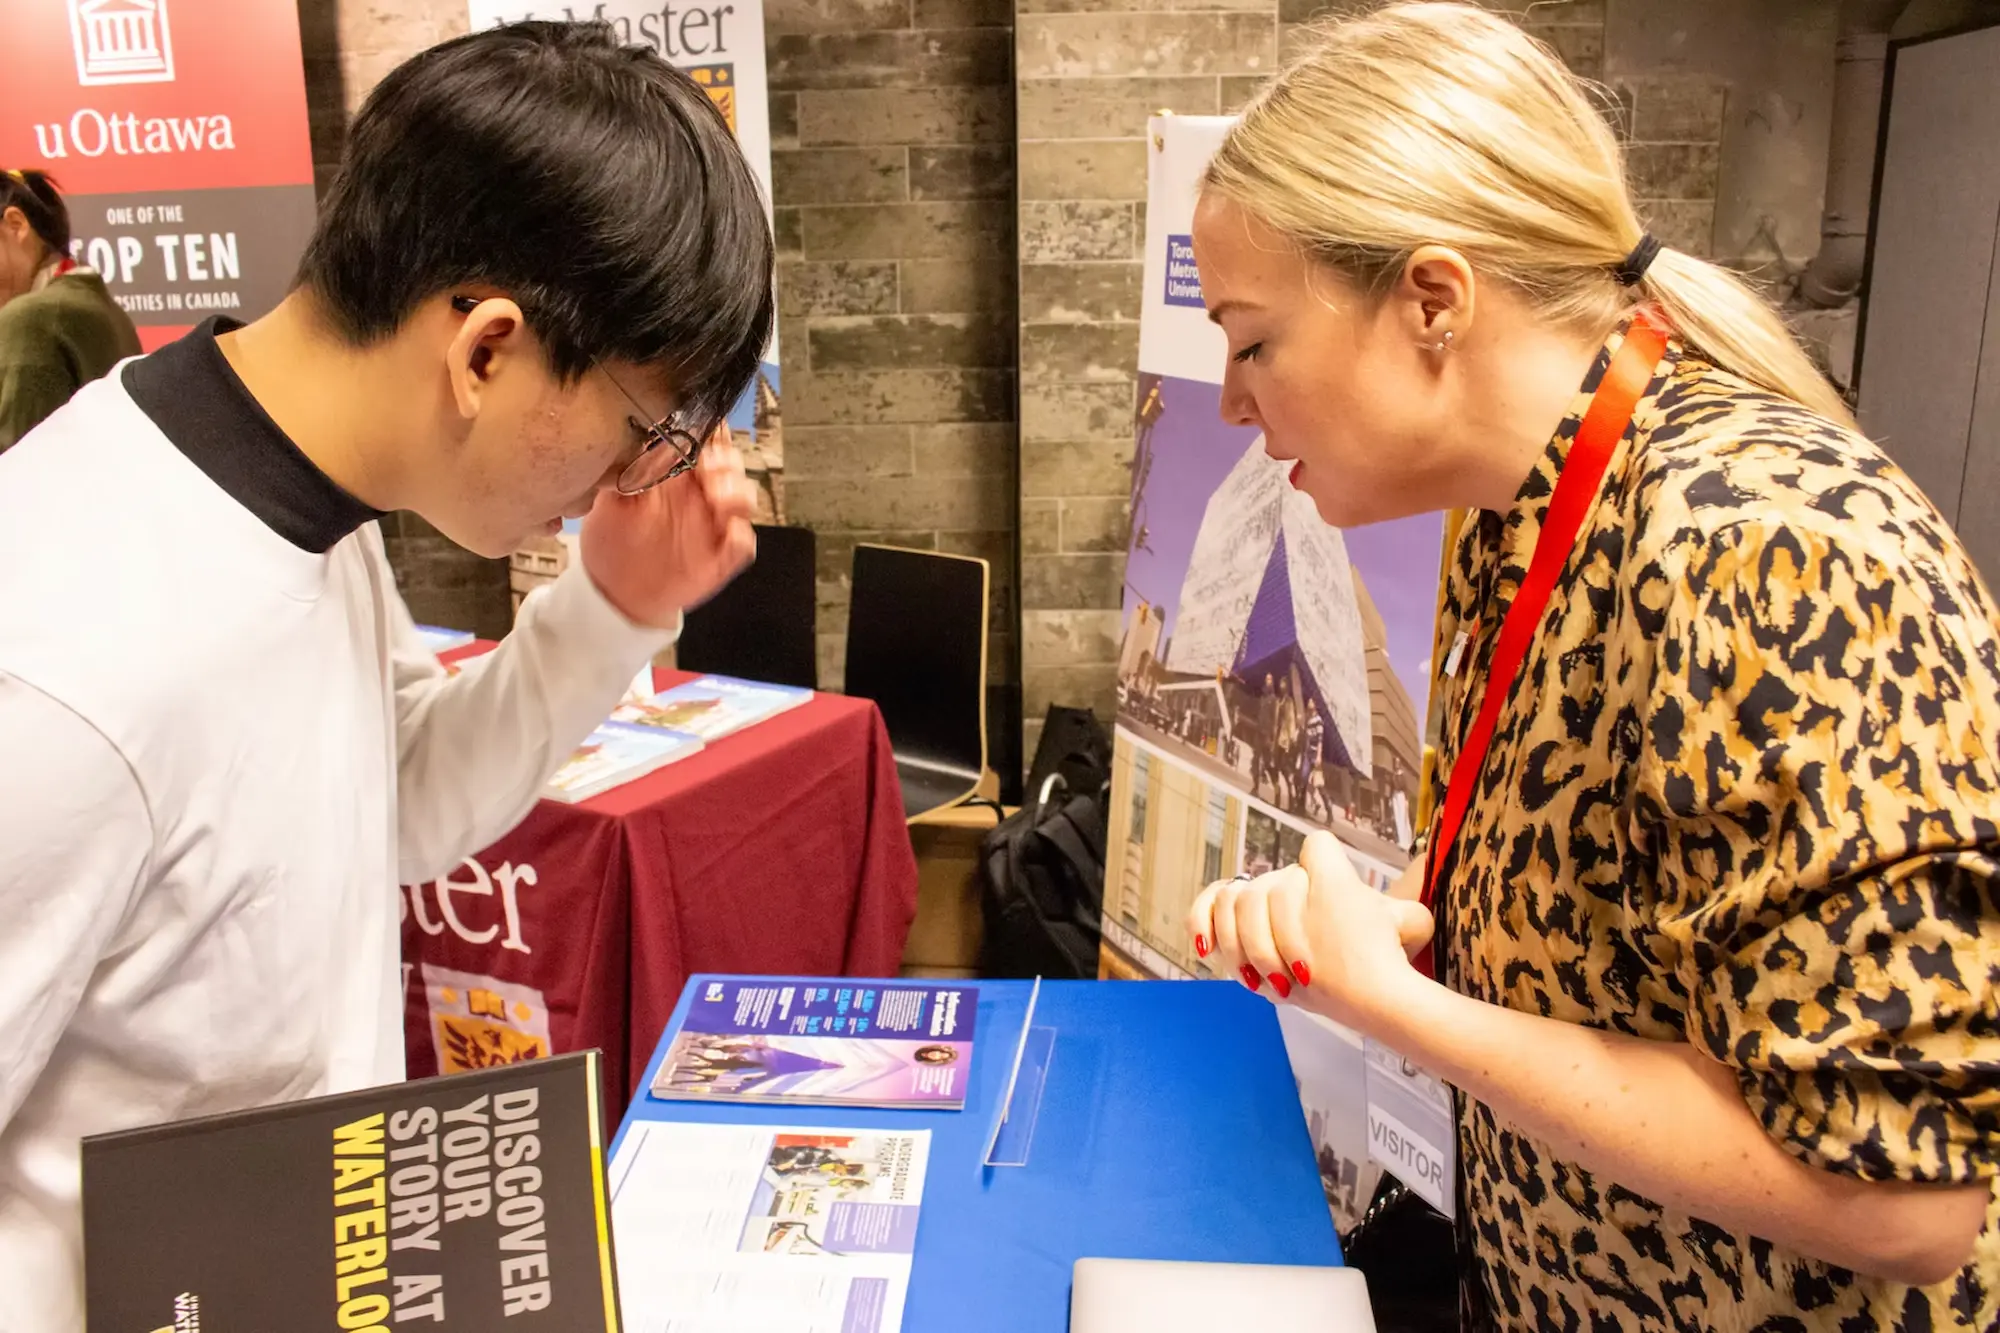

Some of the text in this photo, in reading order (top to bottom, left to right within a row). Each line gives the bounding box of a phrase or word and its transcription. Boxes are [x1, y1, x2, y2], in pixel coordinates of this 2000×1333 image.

[33, 107, 236, 159] uOttawa
[106, 204, 184, 225] ONE OF THE
[155, 232, 240, 282] TEN
[1169, 260, 1200, 281] Metro
[1170, 241, 1195, 259] Toro
[167, 293, 182, 310] IN
[185, 291, 240, 310] CANADA
[442, 1094, 492, 1223] YOUR
[876, 1137, 897, 1177] PROGRAMS
[889, 1137, 914, 1200] UNDERGRADUATE
[1369, 1115, 1444, 1192] VISITOR
[333, 1112, 392, 1333] WATERLO
[388, 1106, 445, 1323] STORY AT
[493, 1087, 551, 1317] DISCOVER
